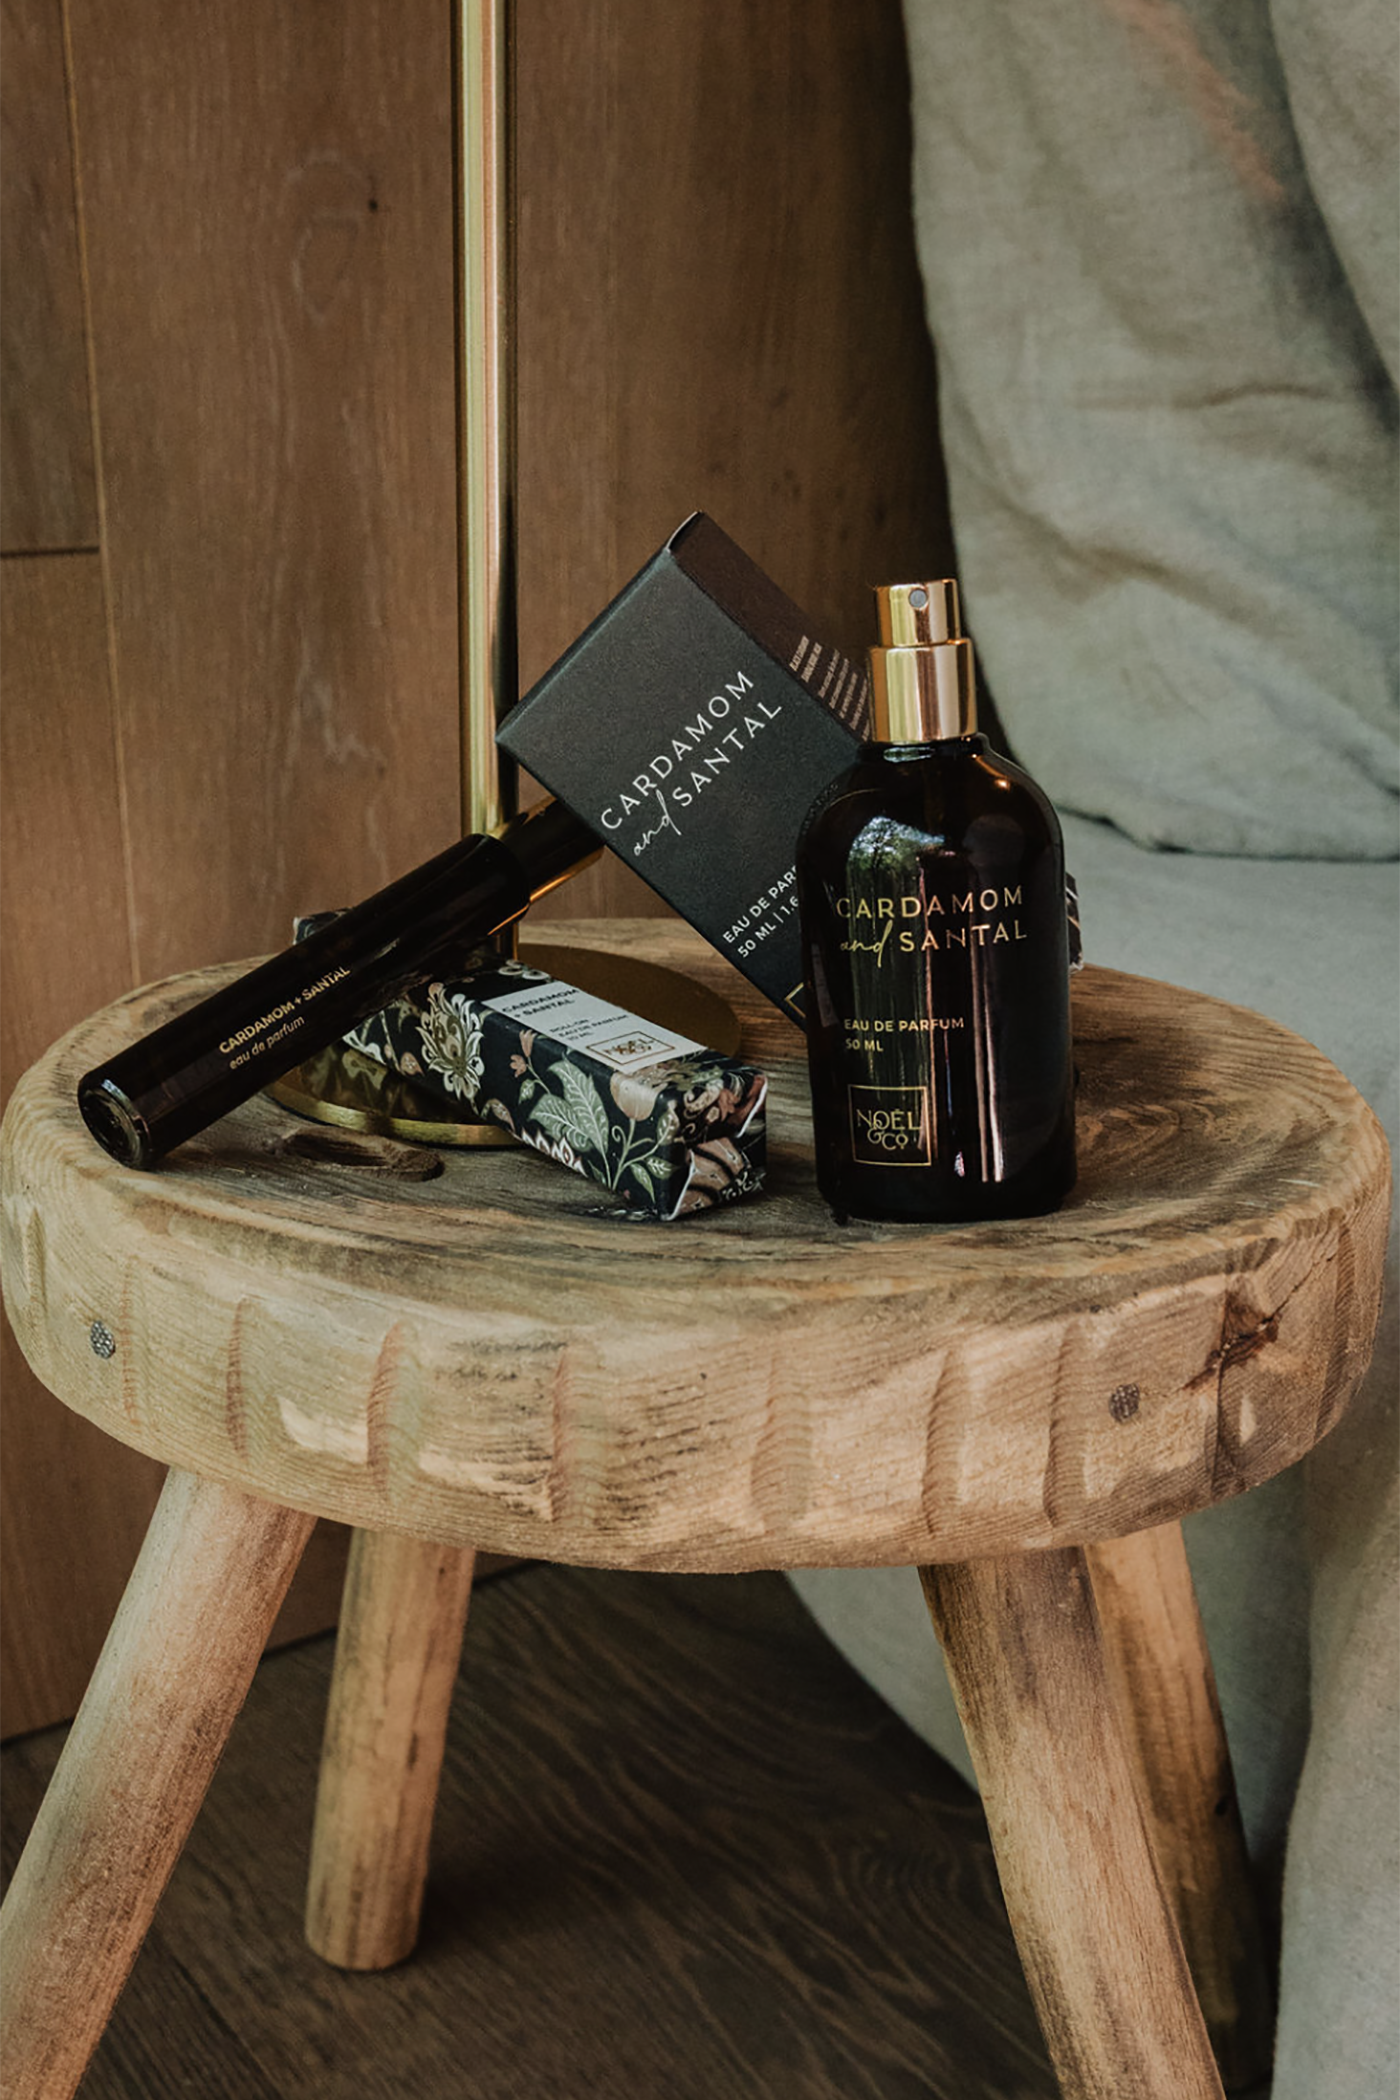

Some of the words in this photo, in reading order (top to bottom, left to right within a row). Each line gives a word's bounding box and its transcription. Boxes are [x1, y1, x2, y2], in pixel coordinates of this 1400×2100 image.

[601, 671, 754, 829] CARDAMOM
[633, 789, 682, 856] and
[672, 702, 782, 807] SANTAL
[722, 915, 750, 943] EAU
[749, 897, 770, 918] DE
[836, 885, 1022, 919] CARDAMOM
[737, 940, 756, 958] 50
[755, 922, 777, 940] ML
[840, 919, 894, 968] and
[899, 919, 1027, 953] SANTAL
[218, 1001, 295, 1054] CARDAMOM
[294, 996, 303, 1006] +
[301, 966, 351, 1001] SANTAL
[502, 988, 580, 1013] CARDAMOM
[229, 1051, 251, 1070] eau
[251, 1042, 266, 1056] de
[266, 1015, 305, 1049] parfum
[844, 1018, 869, 1031] EAU
[874, 1020, 894, 1032] DE
[899, 1017, 964, 1032] PARFUM
[845, 1038, 860, 1050] 50
[864, 1039, 884, 1052] ML
